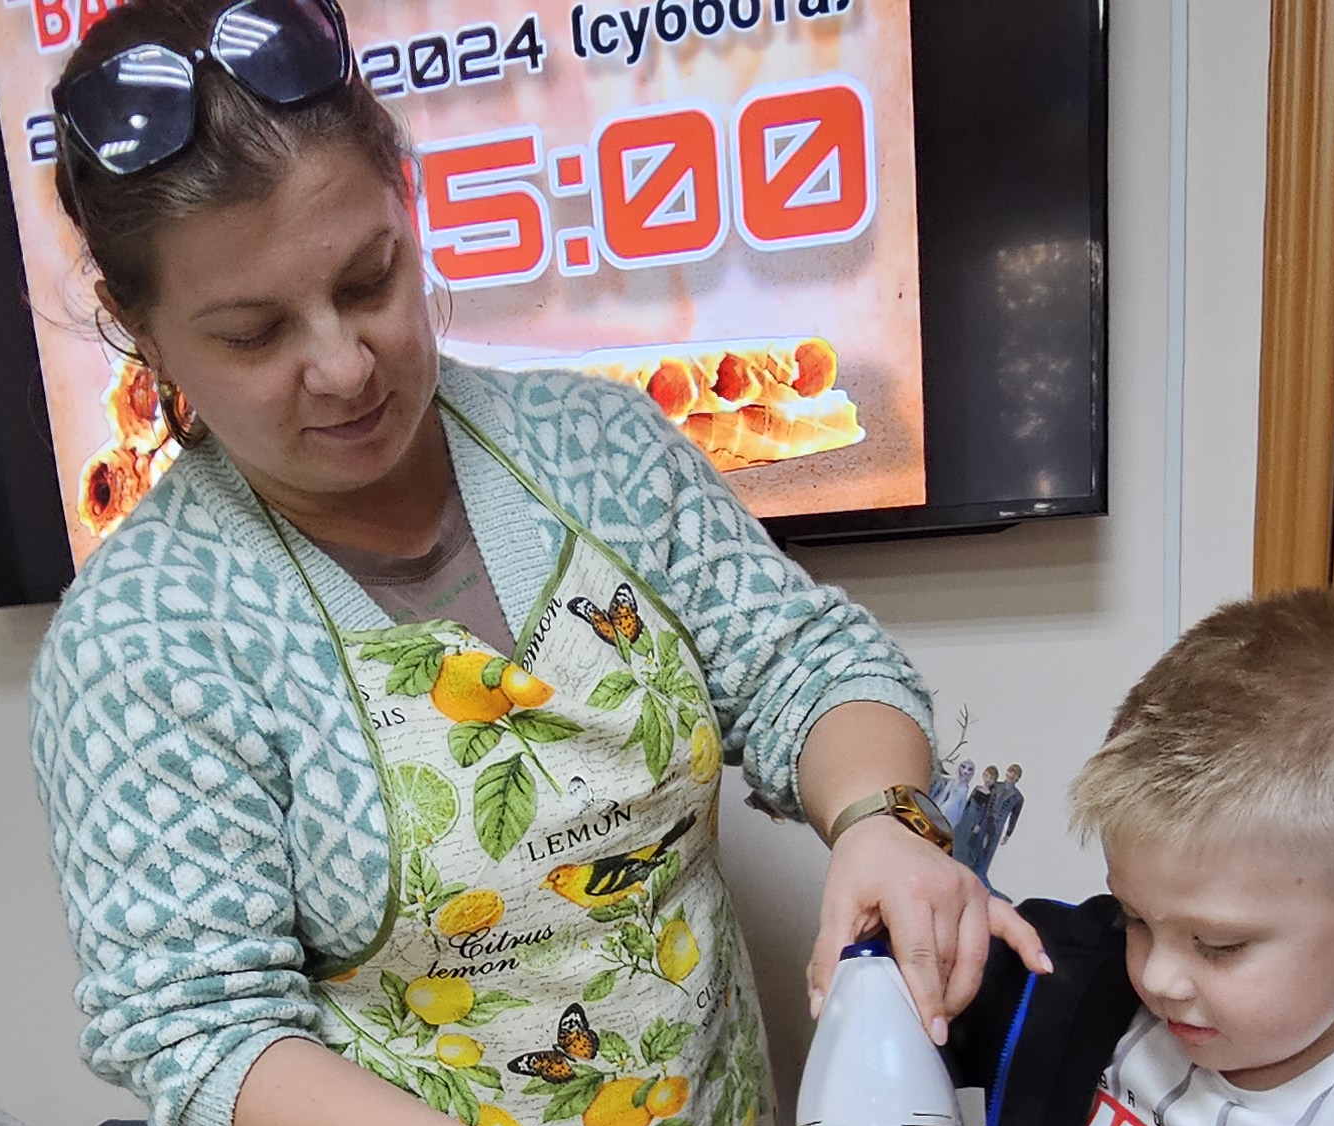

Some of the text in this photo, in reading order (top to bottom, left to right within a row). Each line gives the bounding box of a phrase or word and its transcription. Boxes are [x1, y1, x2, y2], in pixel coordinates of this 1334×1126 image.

[403, 84, 869, 282] 5:00
[527, 804, 633, 862] LEMON
[448, 924, 555, 961] Citrus
[426, 956, 521, 980] lemon
